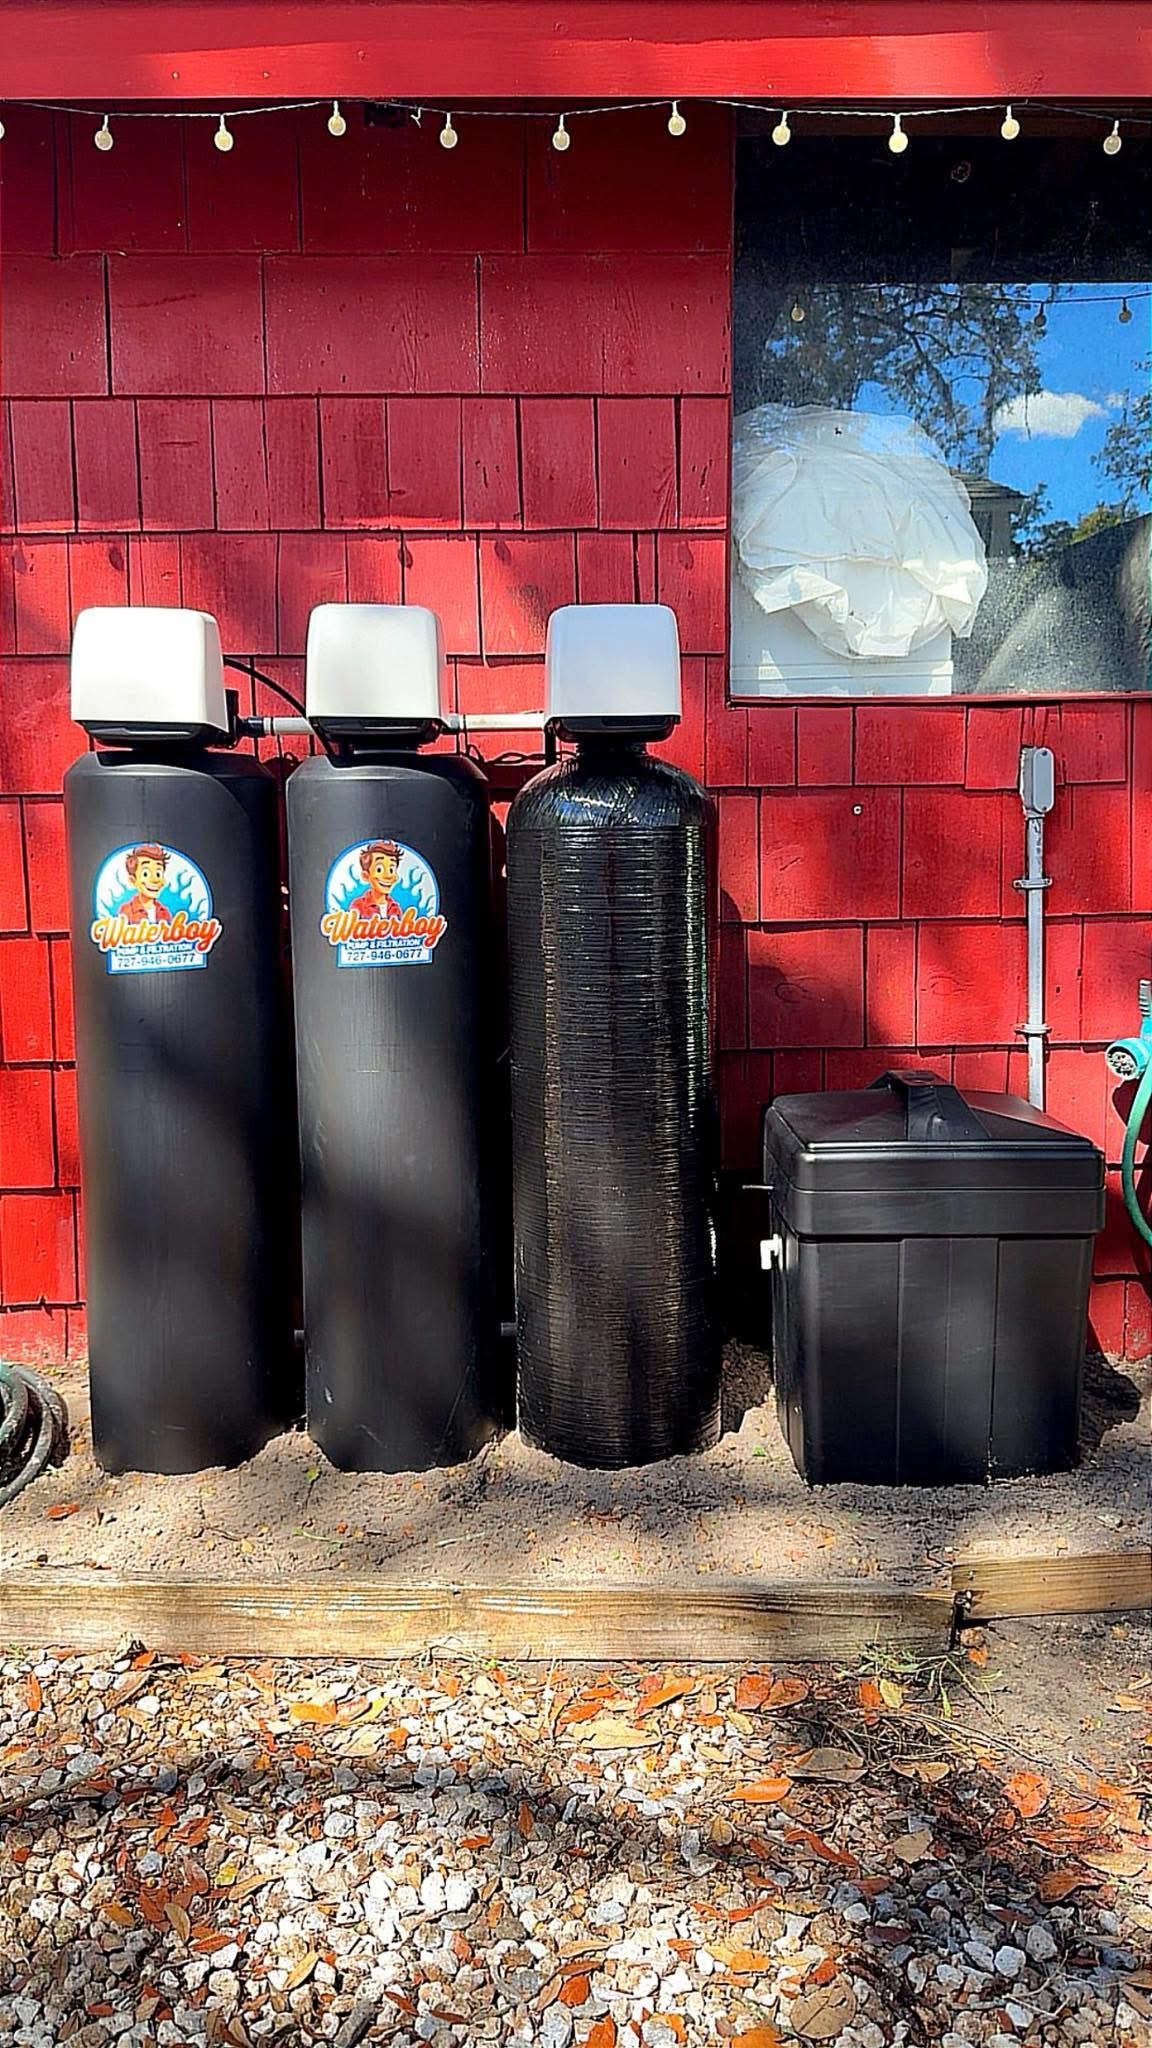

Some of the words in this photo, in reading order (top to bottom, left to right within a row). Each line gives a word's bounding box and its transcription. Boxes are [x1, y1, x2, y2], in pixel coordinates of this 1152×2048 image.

[93, 911, 219, 951] Waterboy
[323, 908, 445, 947] Waterboy
[147, 943, 193, 954] FILTRATION
[346, 940, 369, 950] PUMP
[377, 938, 420, 948] FILTRATION
[117, 953, 196, 968] 727-946-0677
[347, 948, 423, 961] 727-946-0677
